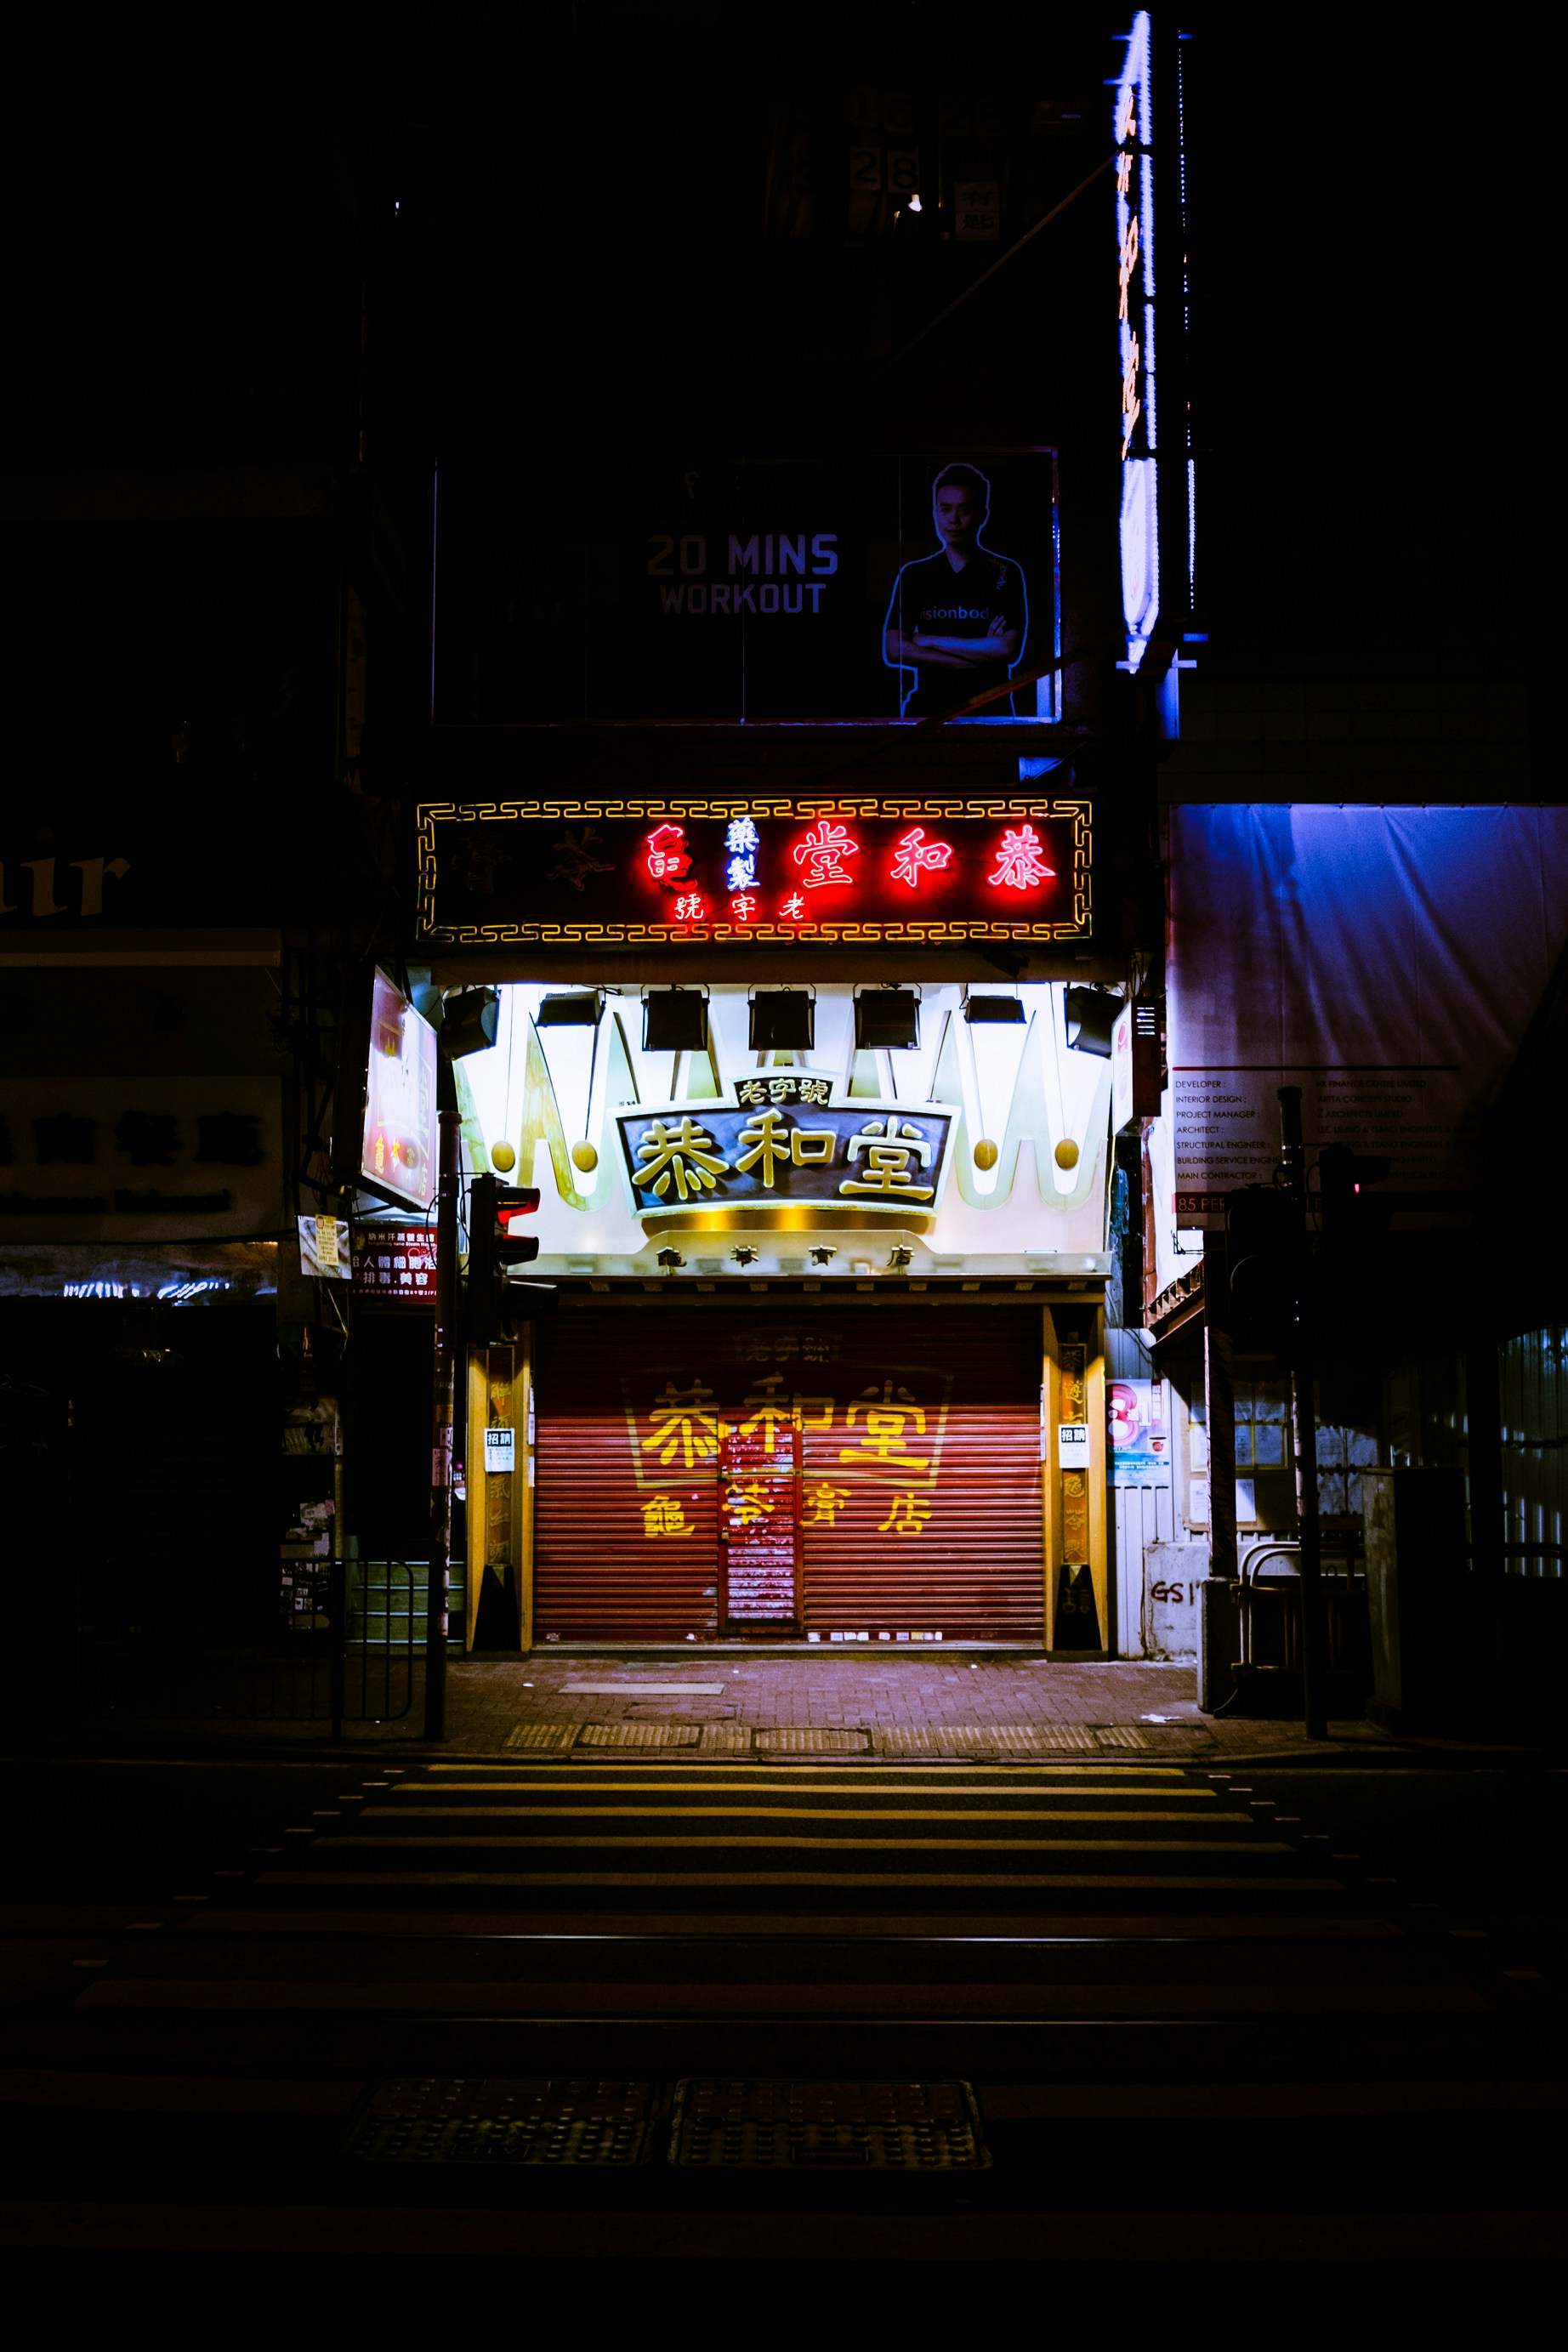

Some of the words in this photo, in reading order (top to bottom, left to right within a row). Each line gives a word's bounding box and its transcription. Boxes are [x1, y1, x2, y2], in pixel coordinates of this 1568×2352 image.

[646, 533, 707, 577] 20
[727, 533, 839, 577] MINS
[659, 582, 827, 615] WORKOUT
[740, 1078, 829, 1105] 老字號
[632, 1108, 935, 1201] 恭和堂
[1179, 1197, 1196, 1212] 85
[642, 1371, 930, 1470] 恭和堂
[487, 1433, 511, 1445] 招聘
